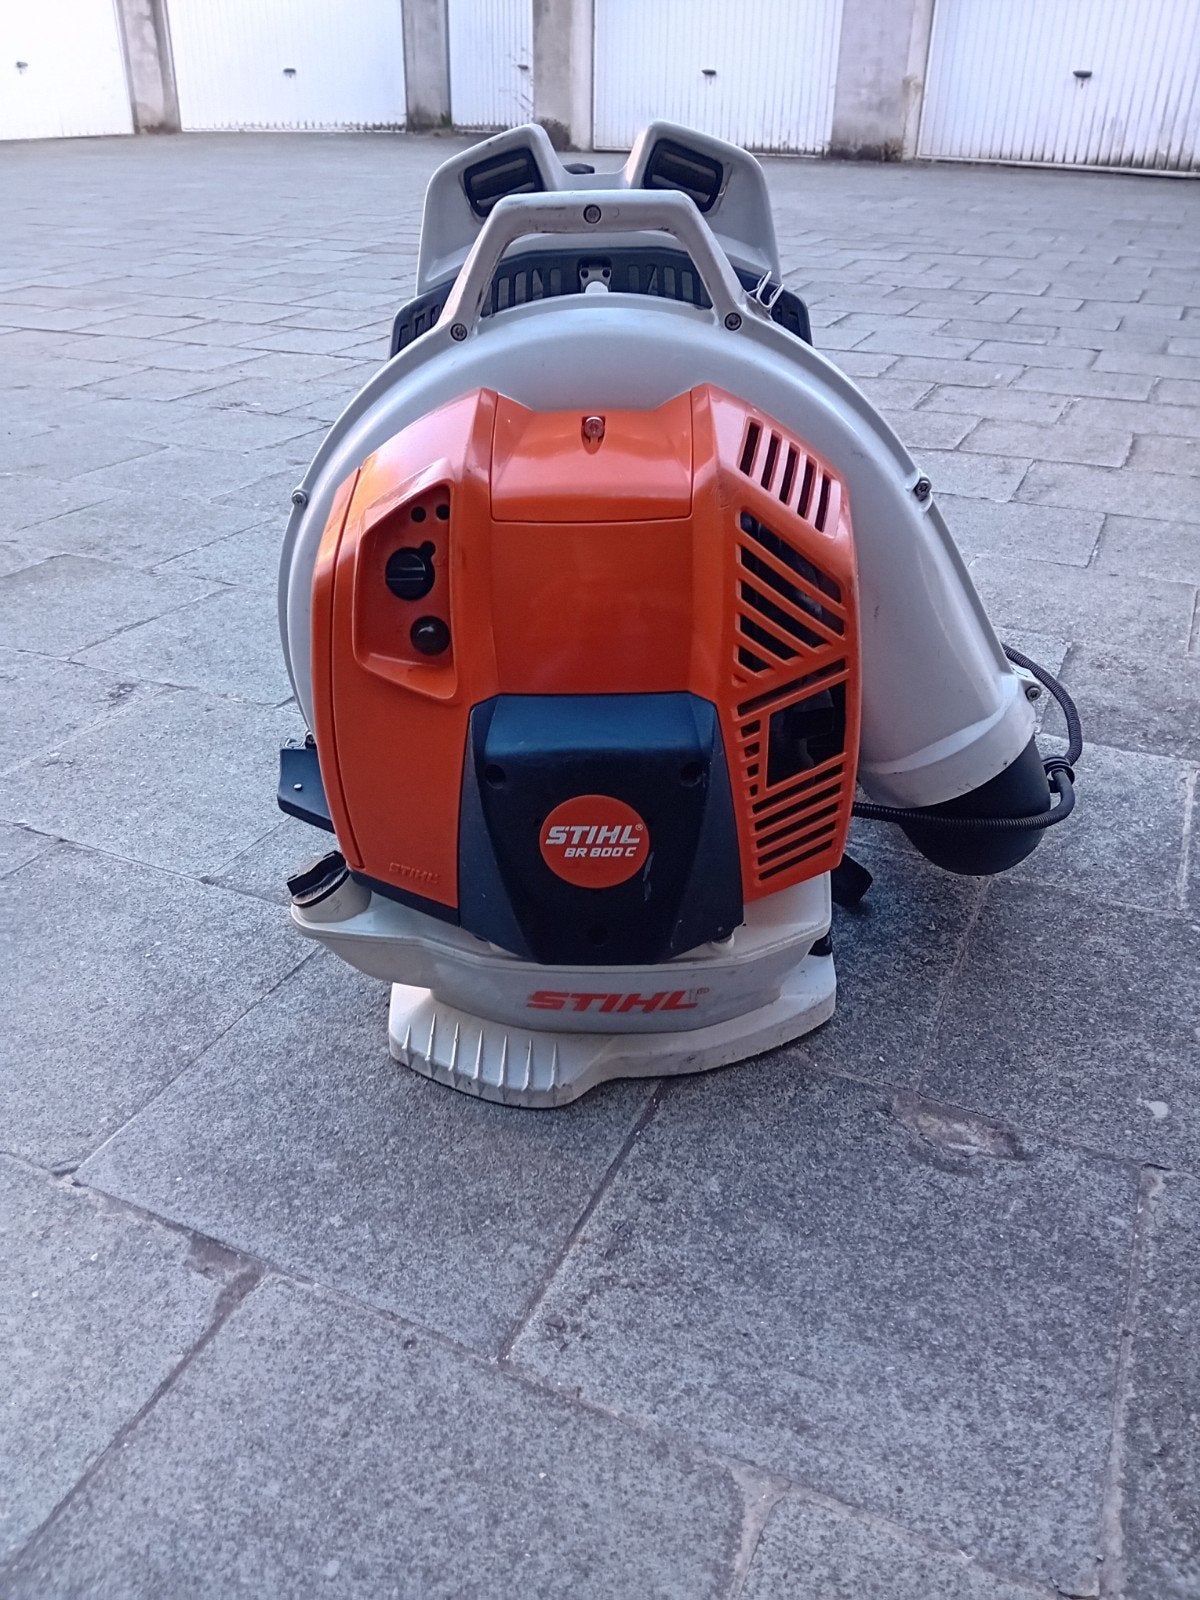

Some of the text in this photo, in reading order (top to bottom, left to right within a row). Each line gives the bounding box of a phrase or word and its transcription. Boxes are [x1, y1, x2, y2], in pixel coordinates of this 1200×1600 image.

[545, 825, 640, 845] STIHL
[564, 846, 637, 858] BR 800 C
[388, 862, 440, 884] STIHL
[525, 990, 699, 1014] STIHL
